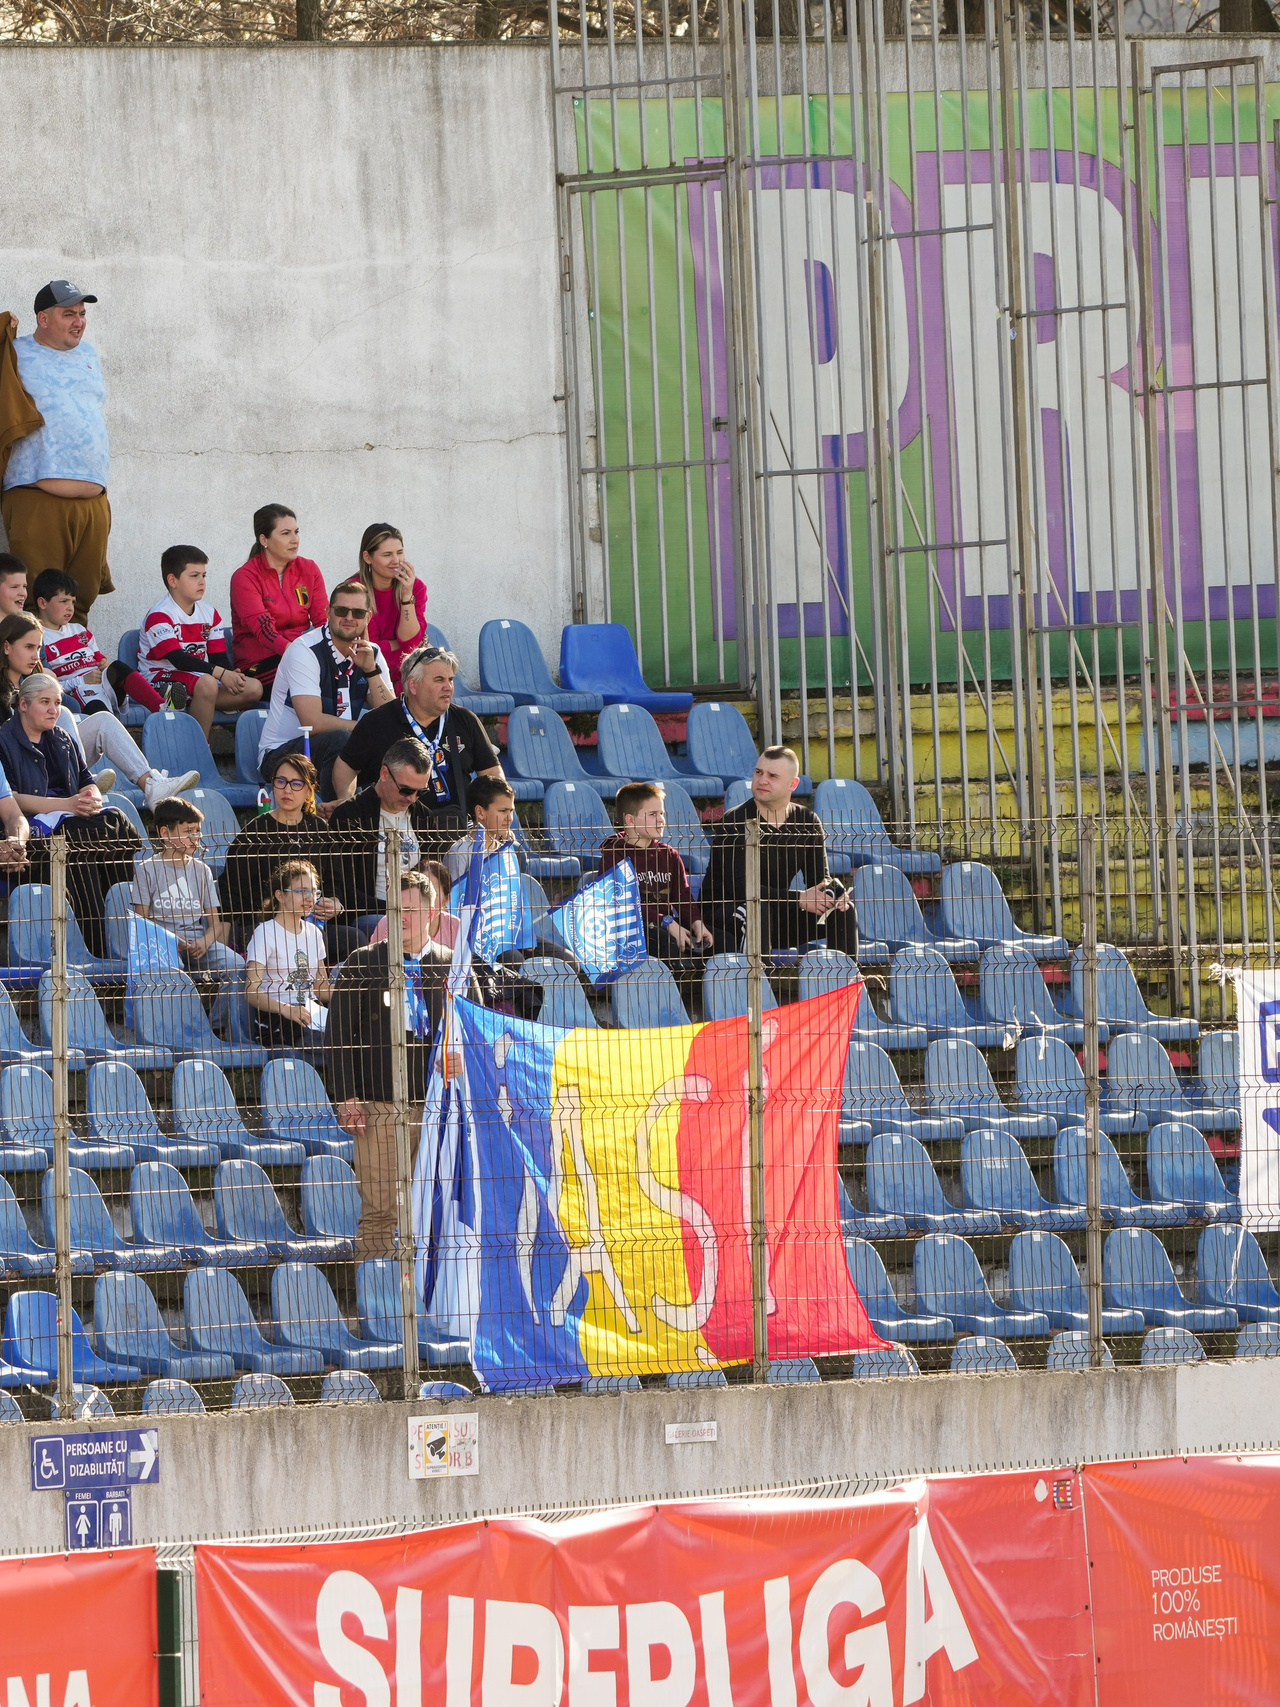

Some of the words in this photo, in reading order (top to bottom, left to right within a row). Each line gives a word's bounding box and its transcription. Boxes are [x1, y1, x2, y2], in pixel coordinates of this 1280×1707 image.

[154, 897, 201, 909] adidas
[66, 1440, 113, 1456] PERSOANE
[115, 1440, 128, 1453] CU
[75, 1492, 92, 1500] FEMEI
[1151, 1564, 1222, 1588] PRODUSE
[313, 1512, 979, 1707] SUPERLIGA
[1152, 1588, 1200, 1614] 100%
[1153, 1616, 1238, 1641] ROMÂNEȘTI
